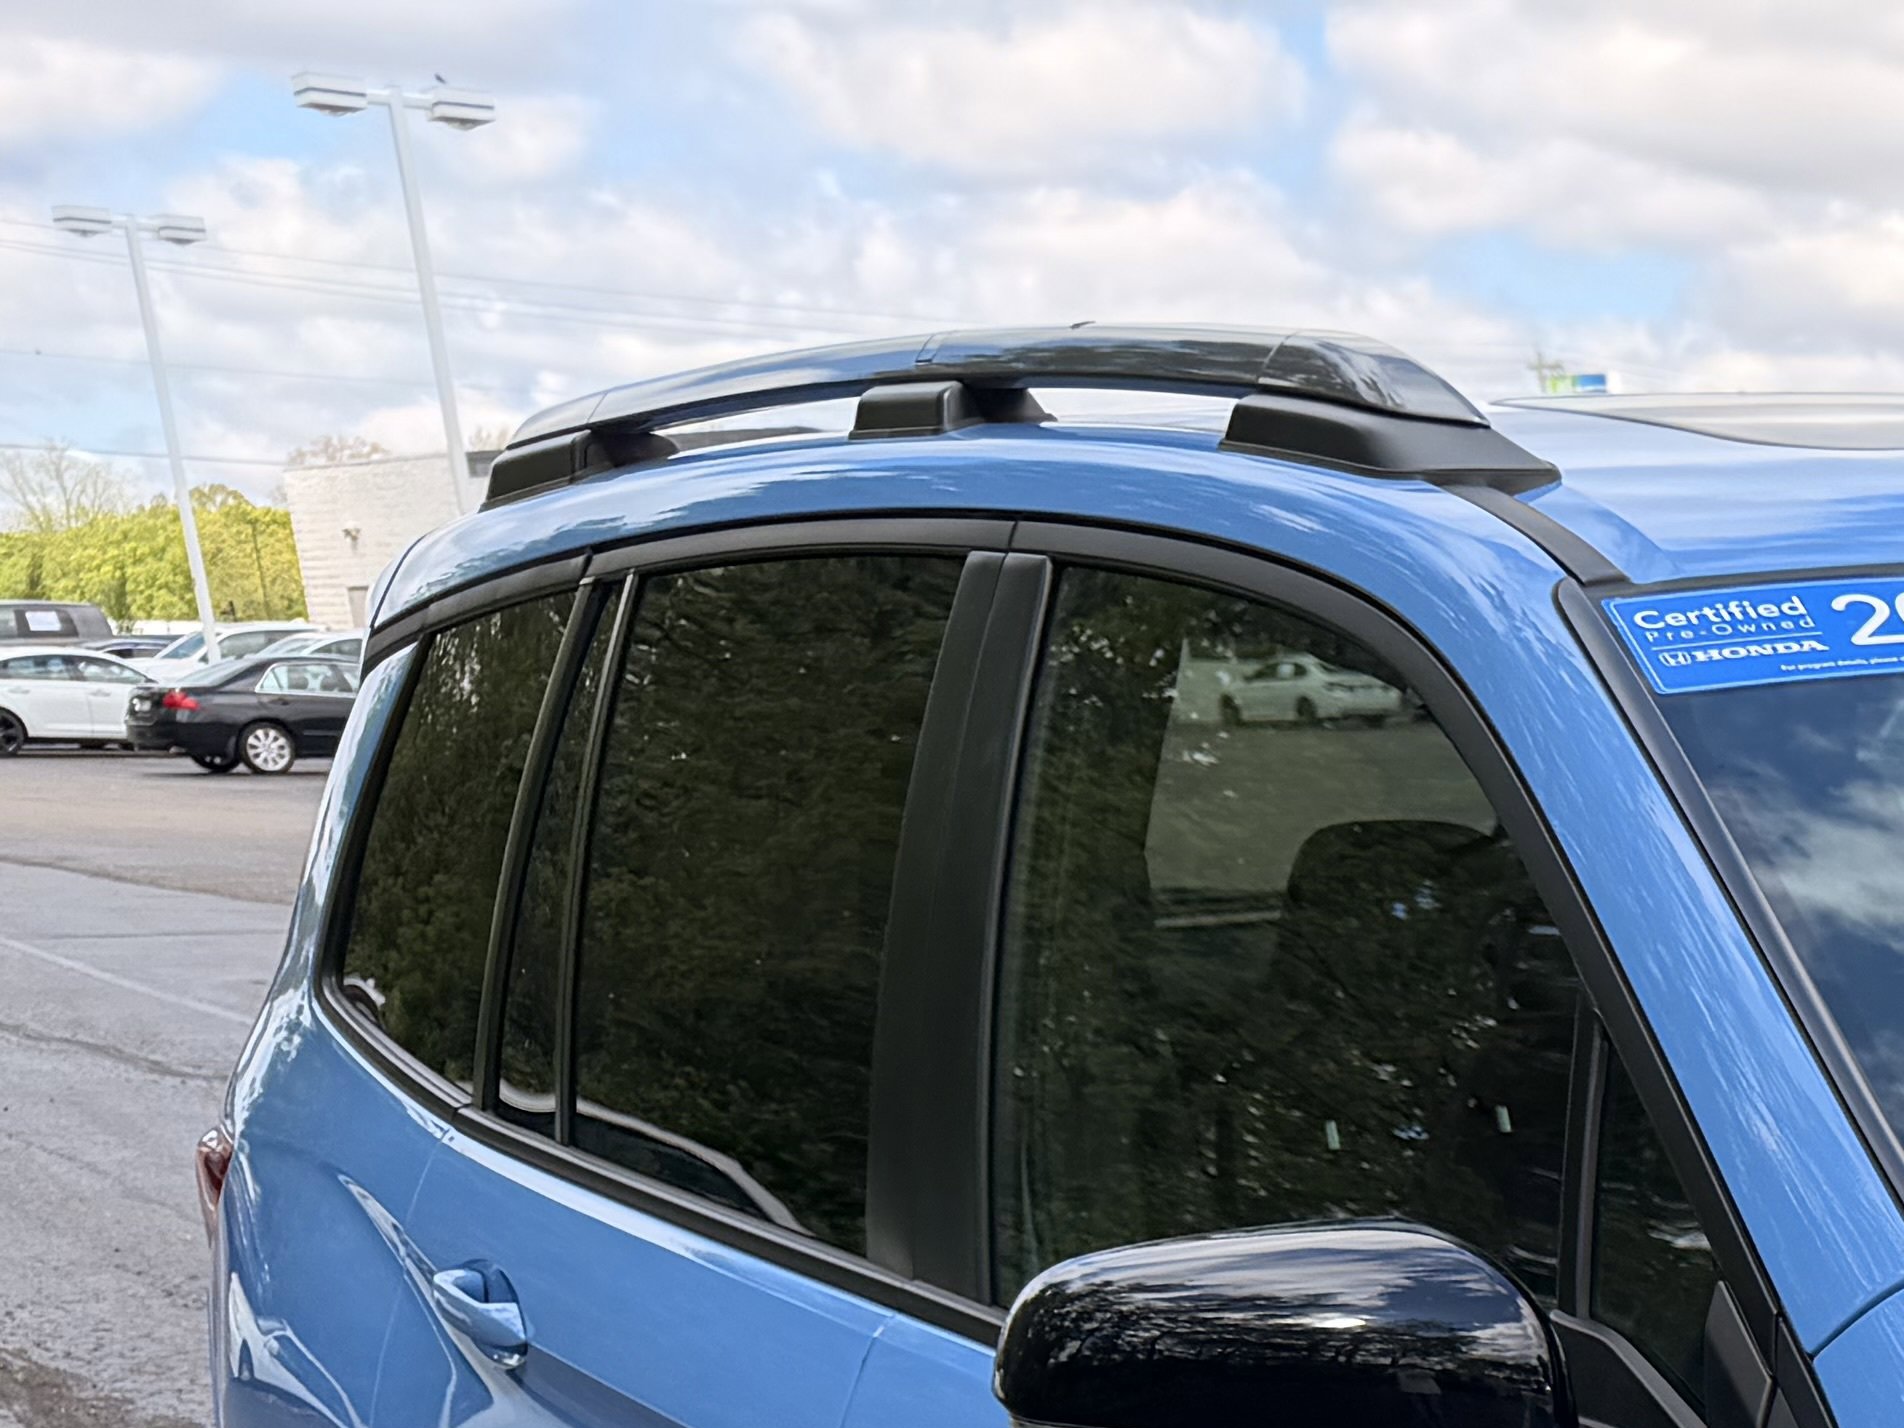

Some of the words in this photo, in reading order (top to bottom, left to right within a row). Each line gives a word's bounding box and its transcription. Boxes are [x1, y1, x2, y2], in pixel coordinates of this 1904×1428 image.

[1633, 596, 1808, 629] Certified
[1645, 616, 1815, 642] Pre-Owned
[1694, 640, 1829, 662] HONDA
